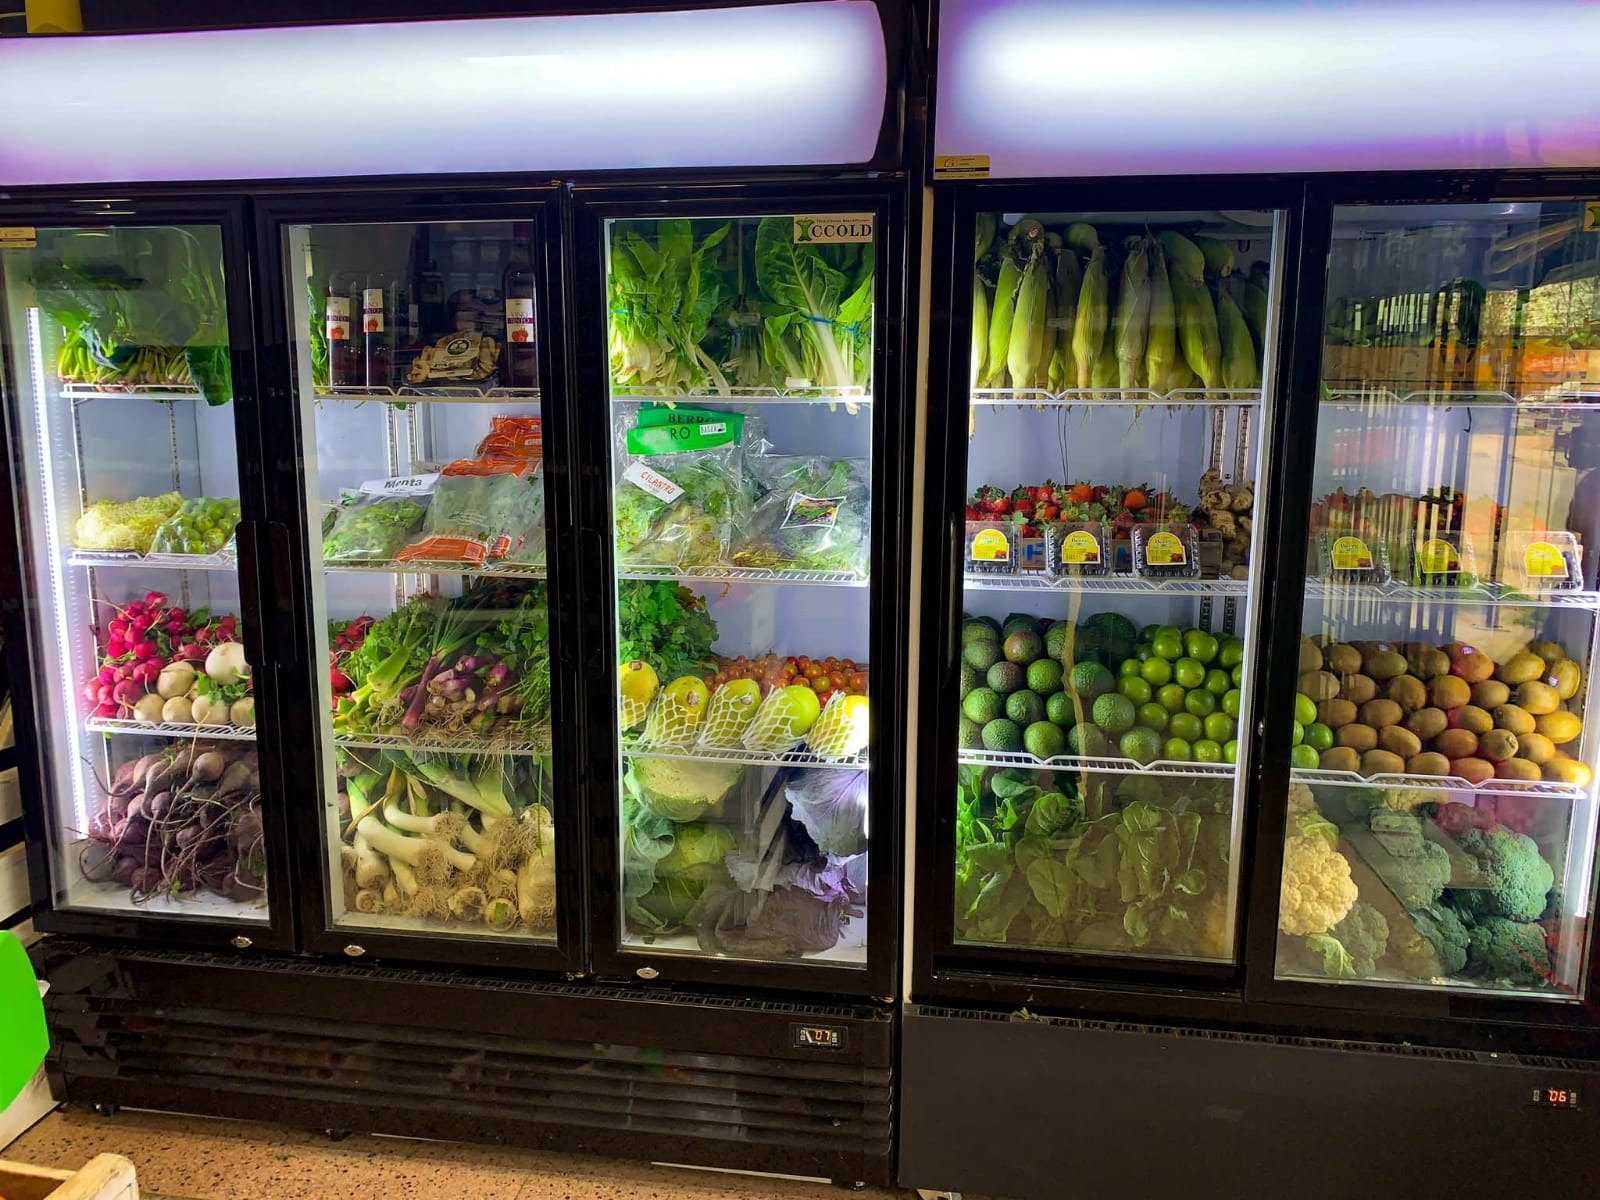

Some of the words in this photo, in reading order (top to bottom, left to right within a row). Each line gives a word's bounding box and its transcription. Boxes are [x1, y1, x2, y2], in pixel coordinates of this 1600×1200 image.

[384, 479, 422, 489] Menta
[640, 471, 675, 494] CILANTRO
[815, 1030, 830, 1041] 07
[1549, 1089, 1567, 1102] 06
